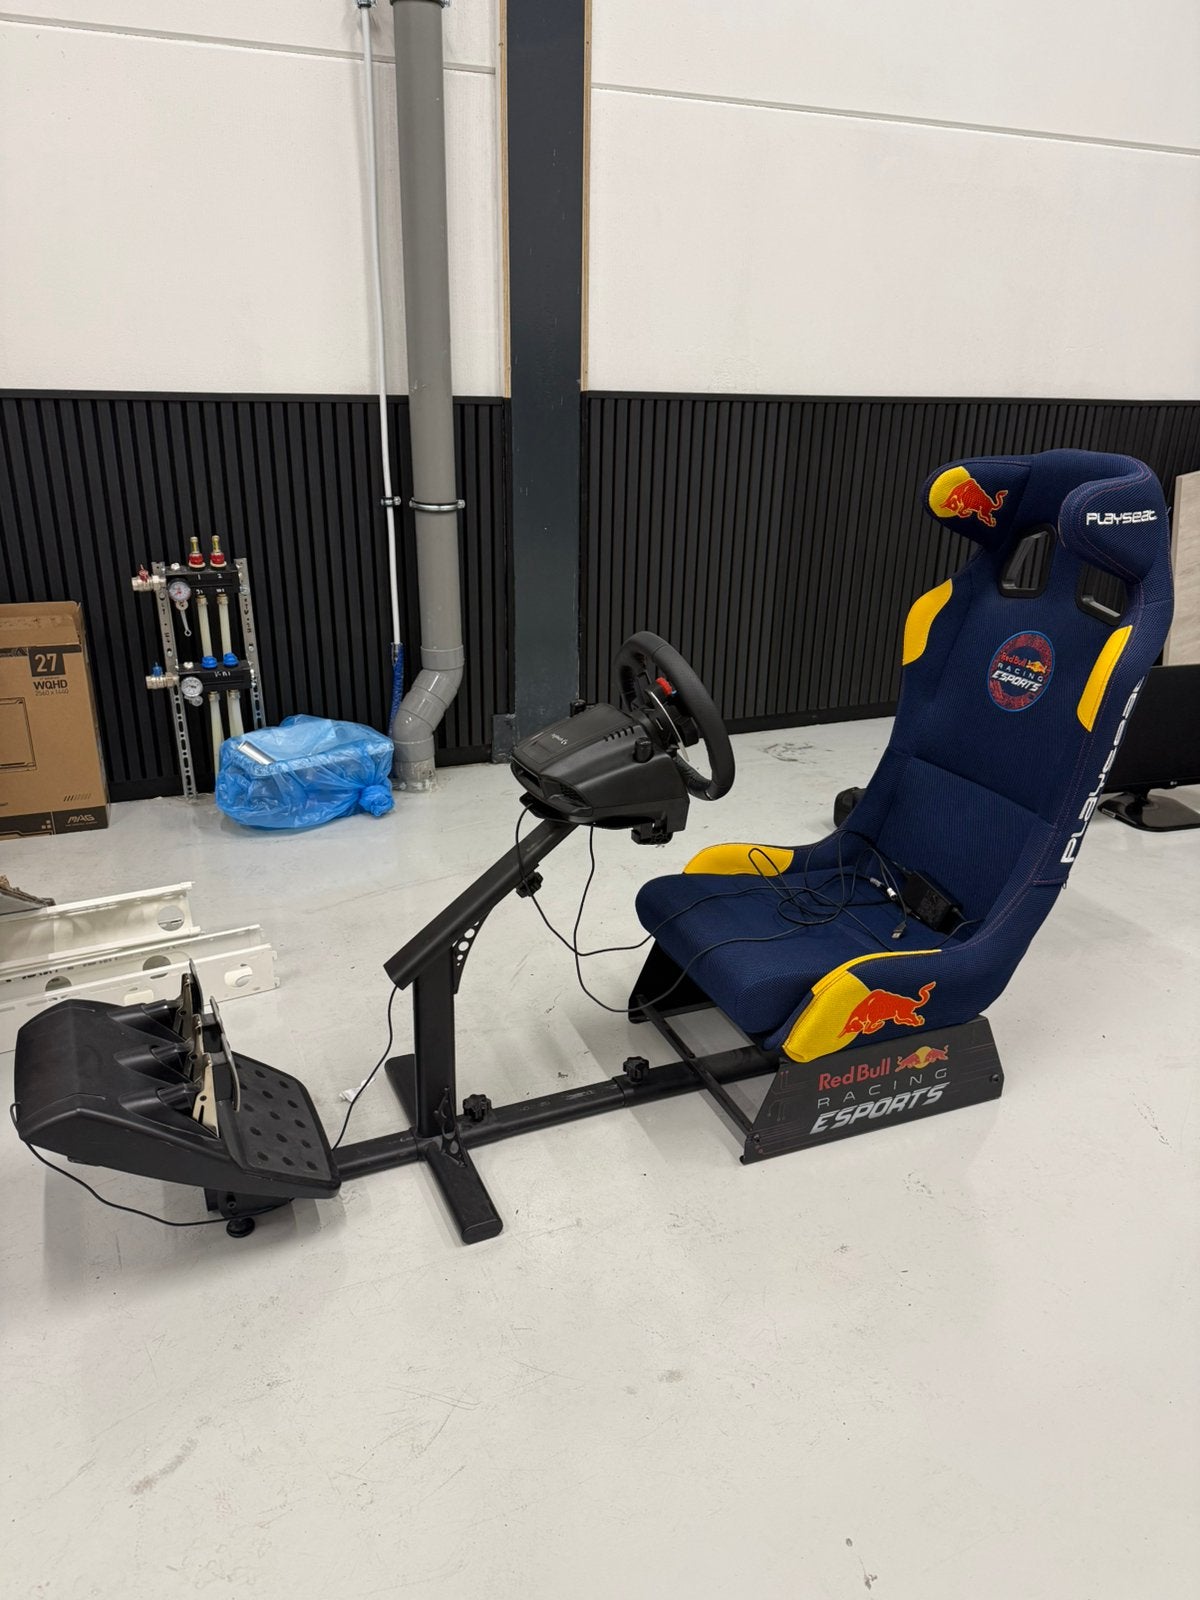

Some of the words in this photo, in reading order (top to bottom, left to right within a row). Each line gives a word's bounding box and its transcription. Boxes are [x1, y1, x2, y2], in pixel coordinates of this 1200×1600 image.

[34, 653, 57, 672] 27
[997, 662, 1044, 682] RACING
[33, 679, 68, 690] WQHD
[991, 670, 1043, 692] ESPORTS
[67, 814, 96, 824] MAG
[818, 1065, 854, 1091] Red
[857, 1057, 891, 1082] Bull
[817, 1068, 948, 1109] RACING
[809, 1081, 951, 1135] ESPORTS
